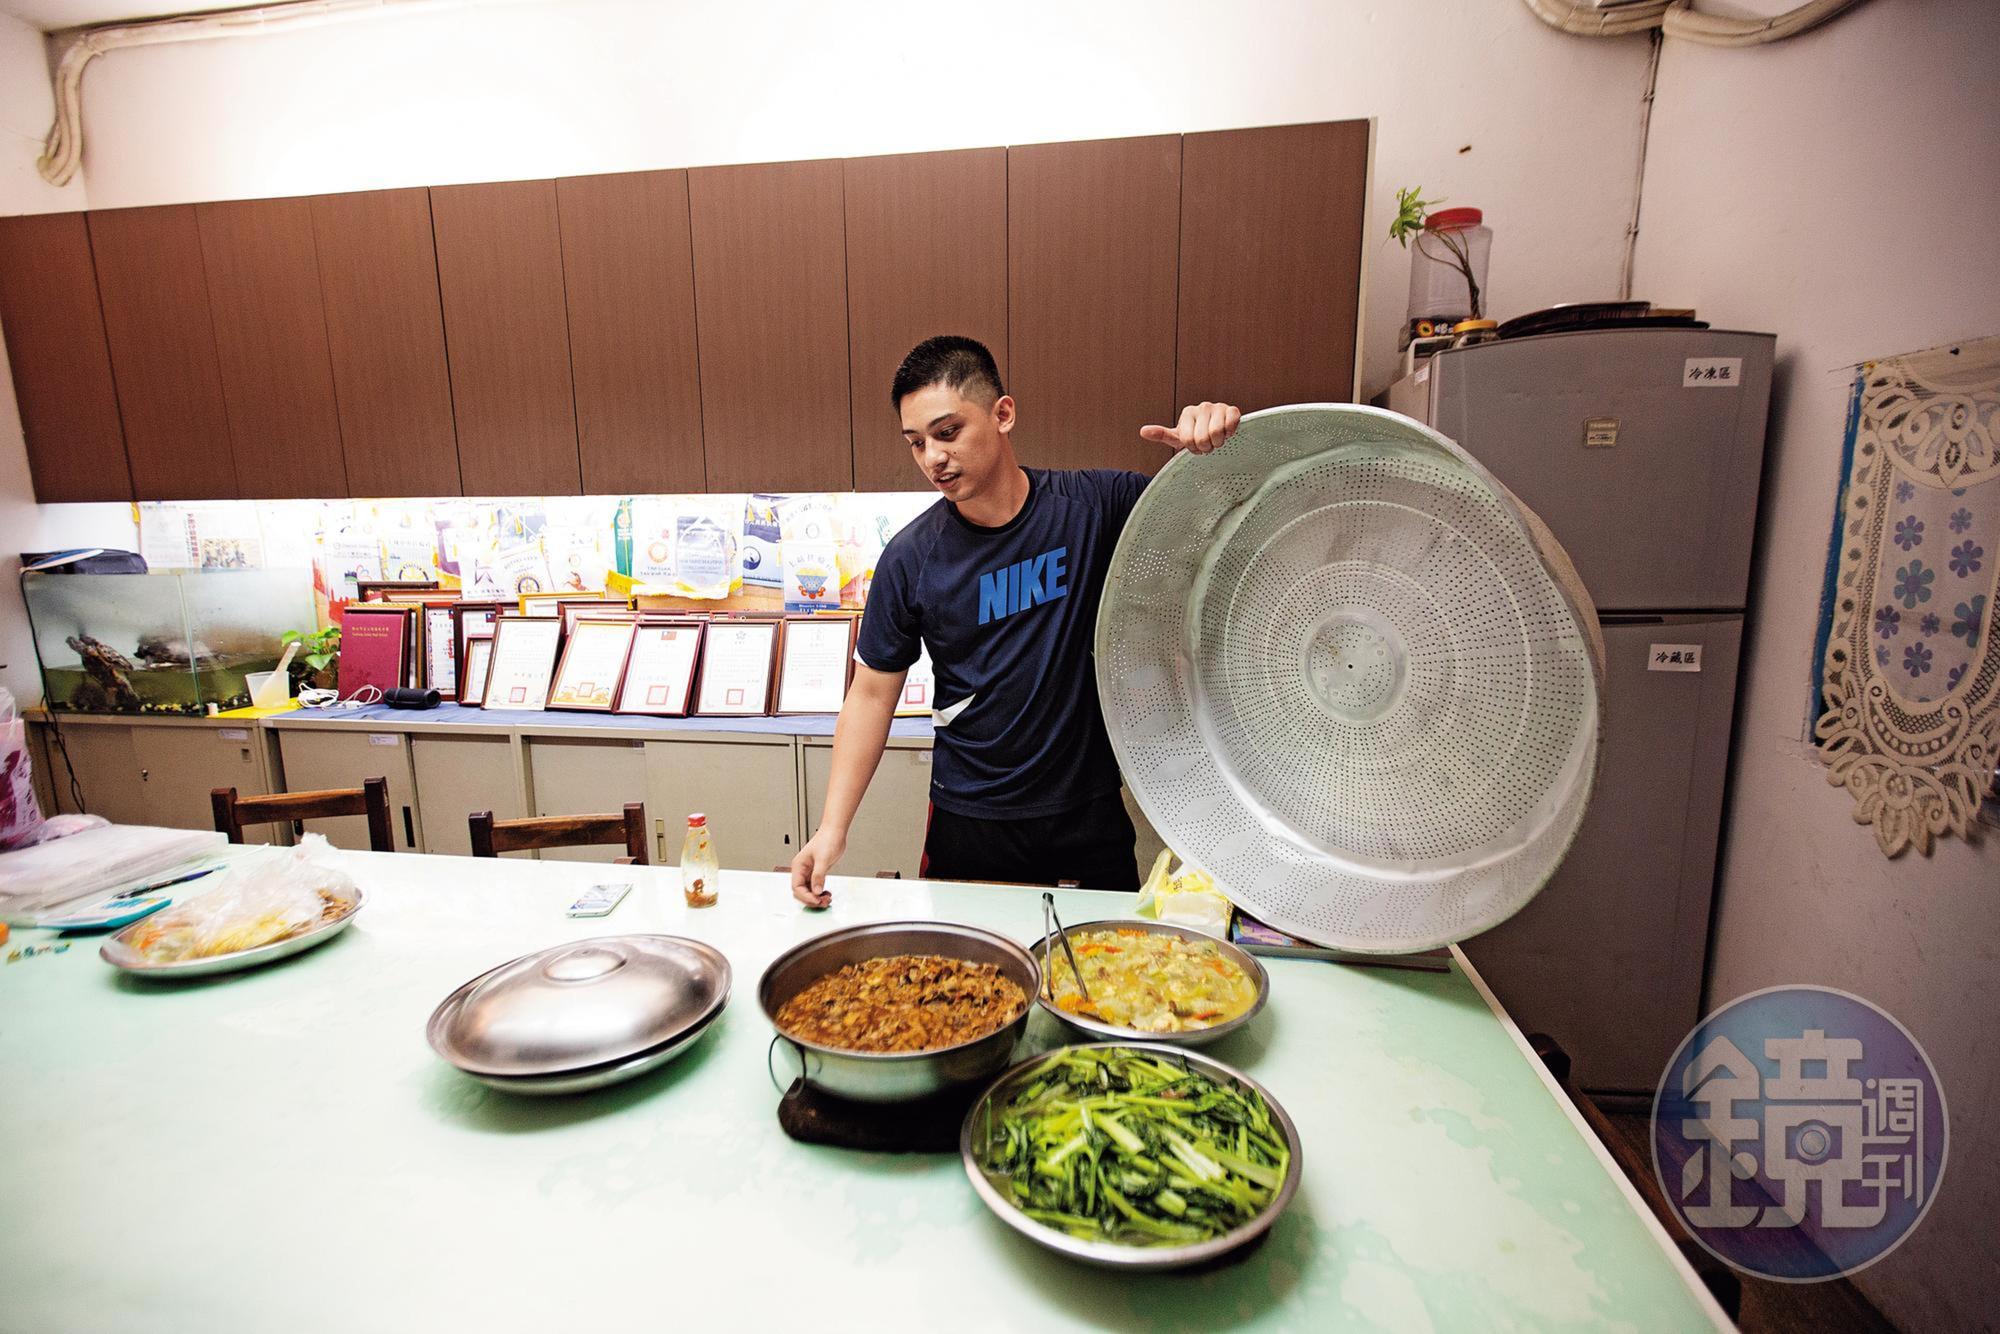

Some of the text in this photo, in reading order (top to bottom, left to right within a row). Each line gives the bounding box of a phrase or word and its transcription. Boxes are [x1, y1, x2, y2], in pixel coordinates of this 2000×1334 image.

[1688, 366, 1731, 380] 冷凍區
[978, 546, 1067, 625] NIKE
[1655, 651, 1696, 664] 冷藏區
